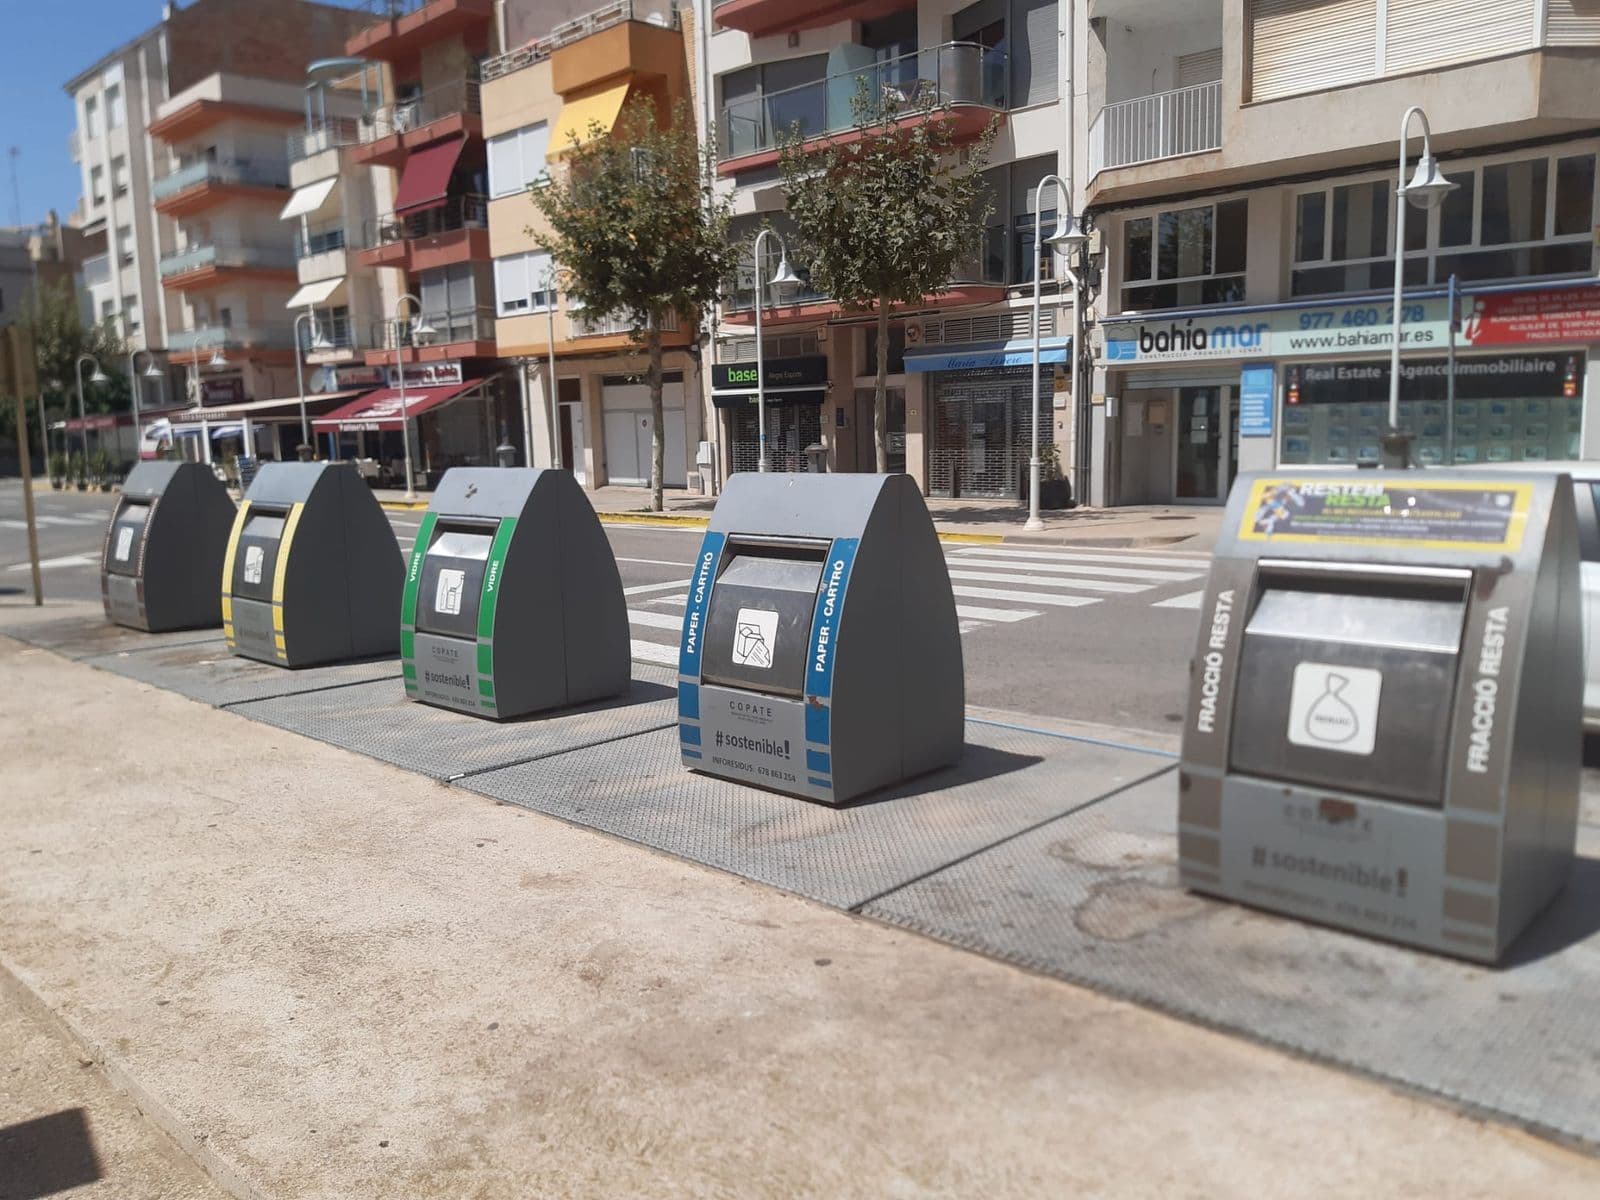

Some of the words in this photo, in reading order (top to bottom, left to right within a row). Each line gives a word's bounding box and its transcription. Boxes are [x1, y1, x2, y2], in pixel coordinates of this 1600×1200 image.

[1299, 312, 1334, 330] 977
[1342, 308, 1378, 327] 460
[1386, 305, 1425, 324] 278
[728, 367, 758, 383] base
[1305, 368, 1335, 380] Real
[1337, 366, 1381, 379] Estate
[1453, 358, 1556, 375] immobiliaire
[1300, 482, 1385, 496] RESTEM
[1326, 494, 1391, 508] RESTA
[409, 552, 421, 582] VIDRE
[487, 560, 500, 593] VIDRE
[687, 611, 699, 654] PAPER
[695, 552, 713, 604] CARTRÓ
[815, 626, 830, 672] PAPER
[823, 560, 844, 617] CARTRÓ
[1209, 589, 1235, 649] RESTA
[1478, 606, 1510, 677] RESTA
[1197, 651, 1224, 733] FRACCIÓ
[729, 700, 772, 717] COPATE
[1466, 677, 1499, 774] FRACCIÓ
[757, 767, 769, 777] 678
